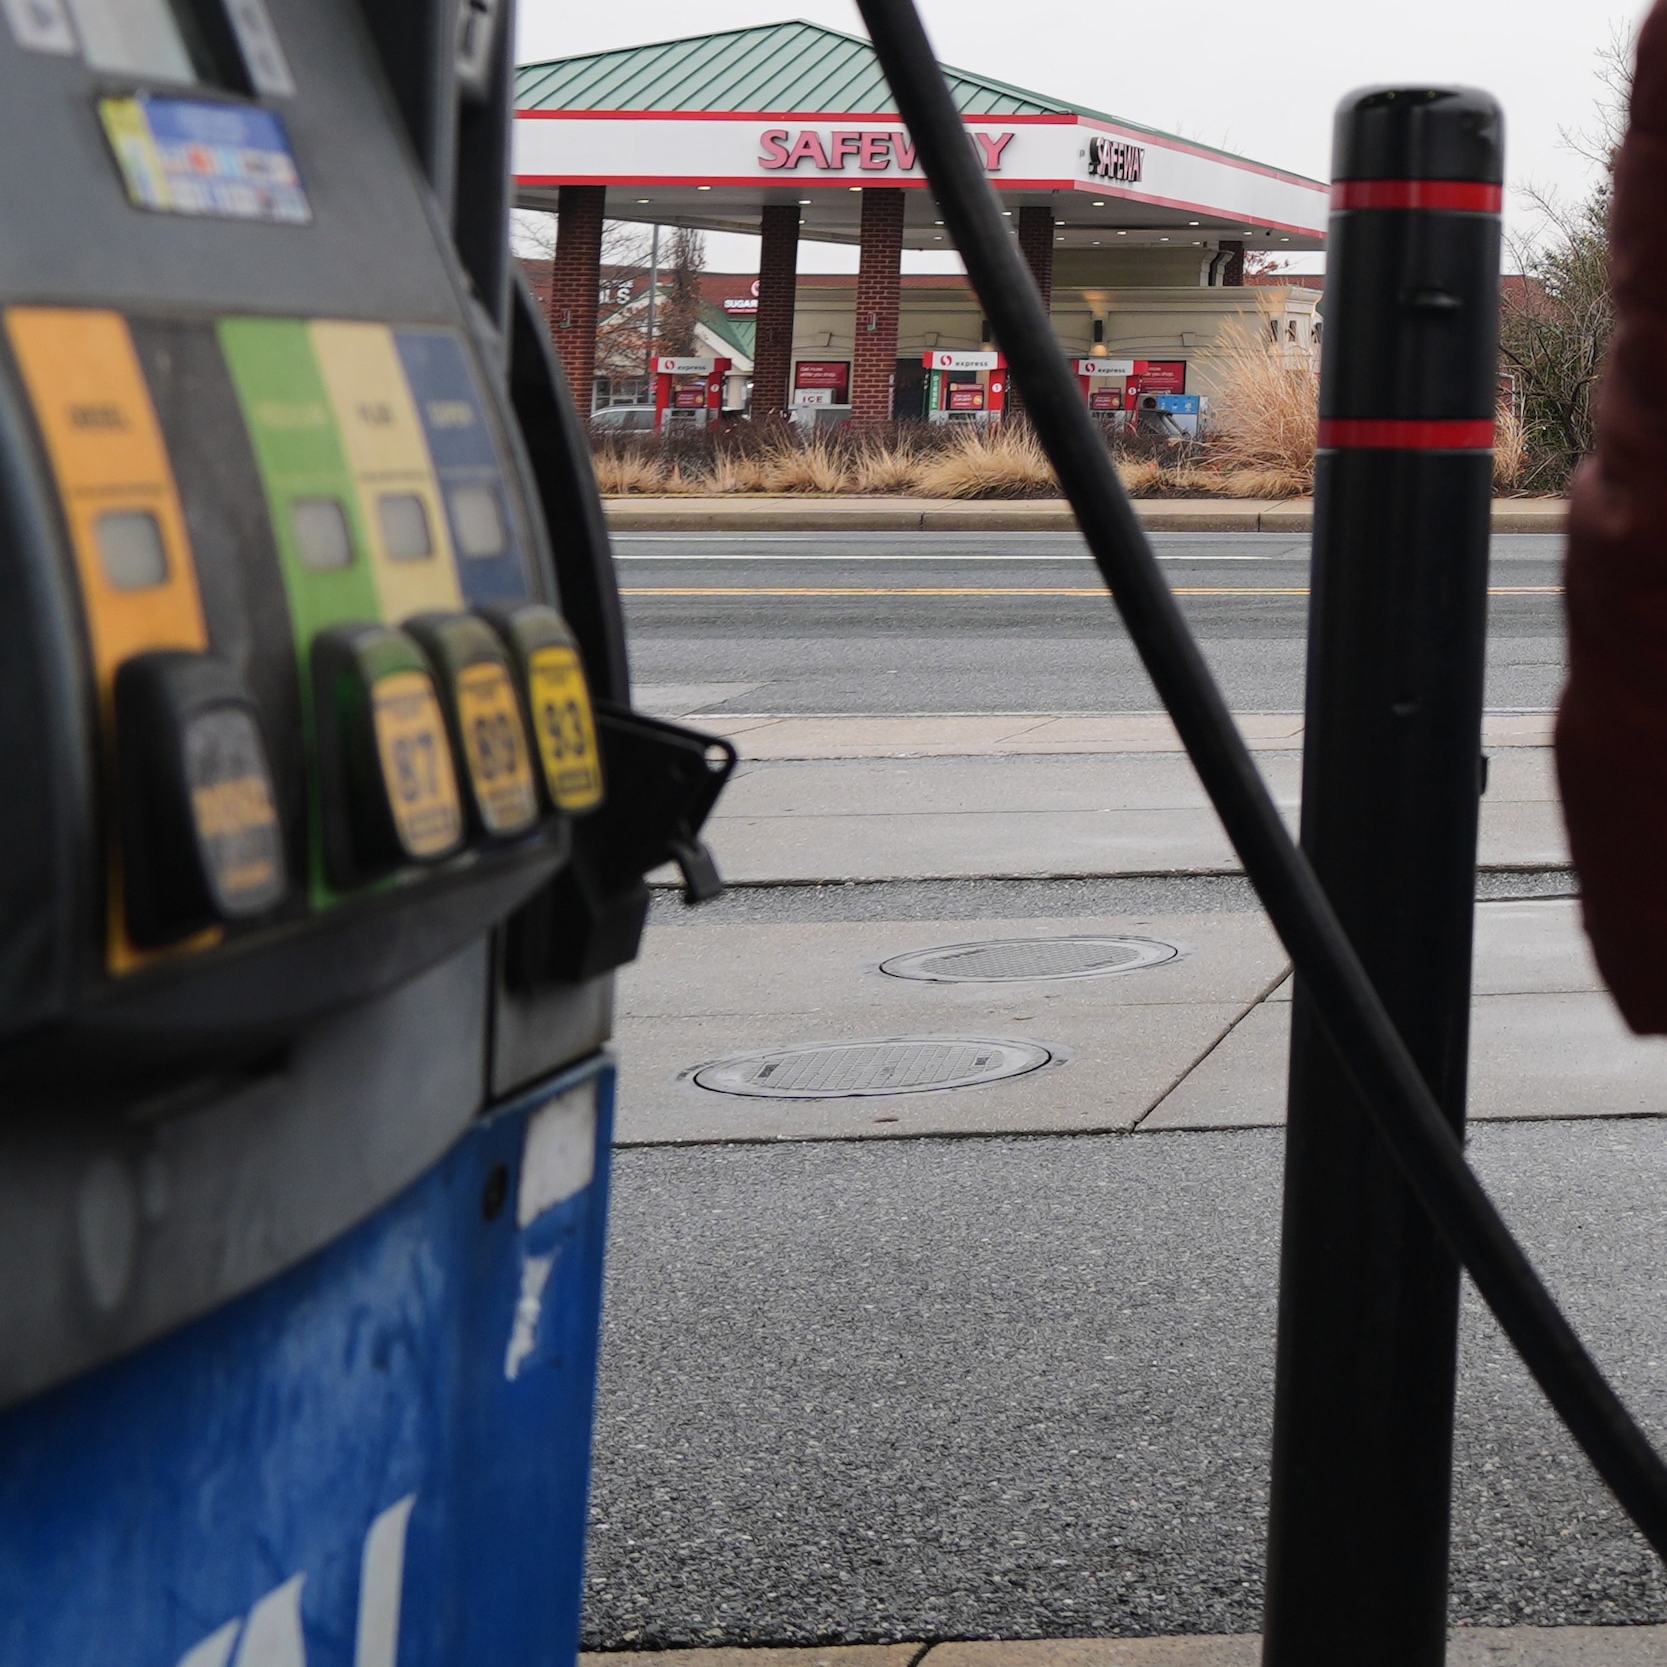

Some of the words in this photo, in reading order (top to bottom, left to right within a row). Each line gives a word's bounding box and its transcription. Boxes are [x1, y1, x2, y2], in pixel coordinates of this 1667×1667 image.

[758, 129, 1016, 171] SAFEY
[1091, 137, 1145, 183] SAFEWAY
[803, 396, 824, 404] ICE
[545, 697, 586, 761] 93
